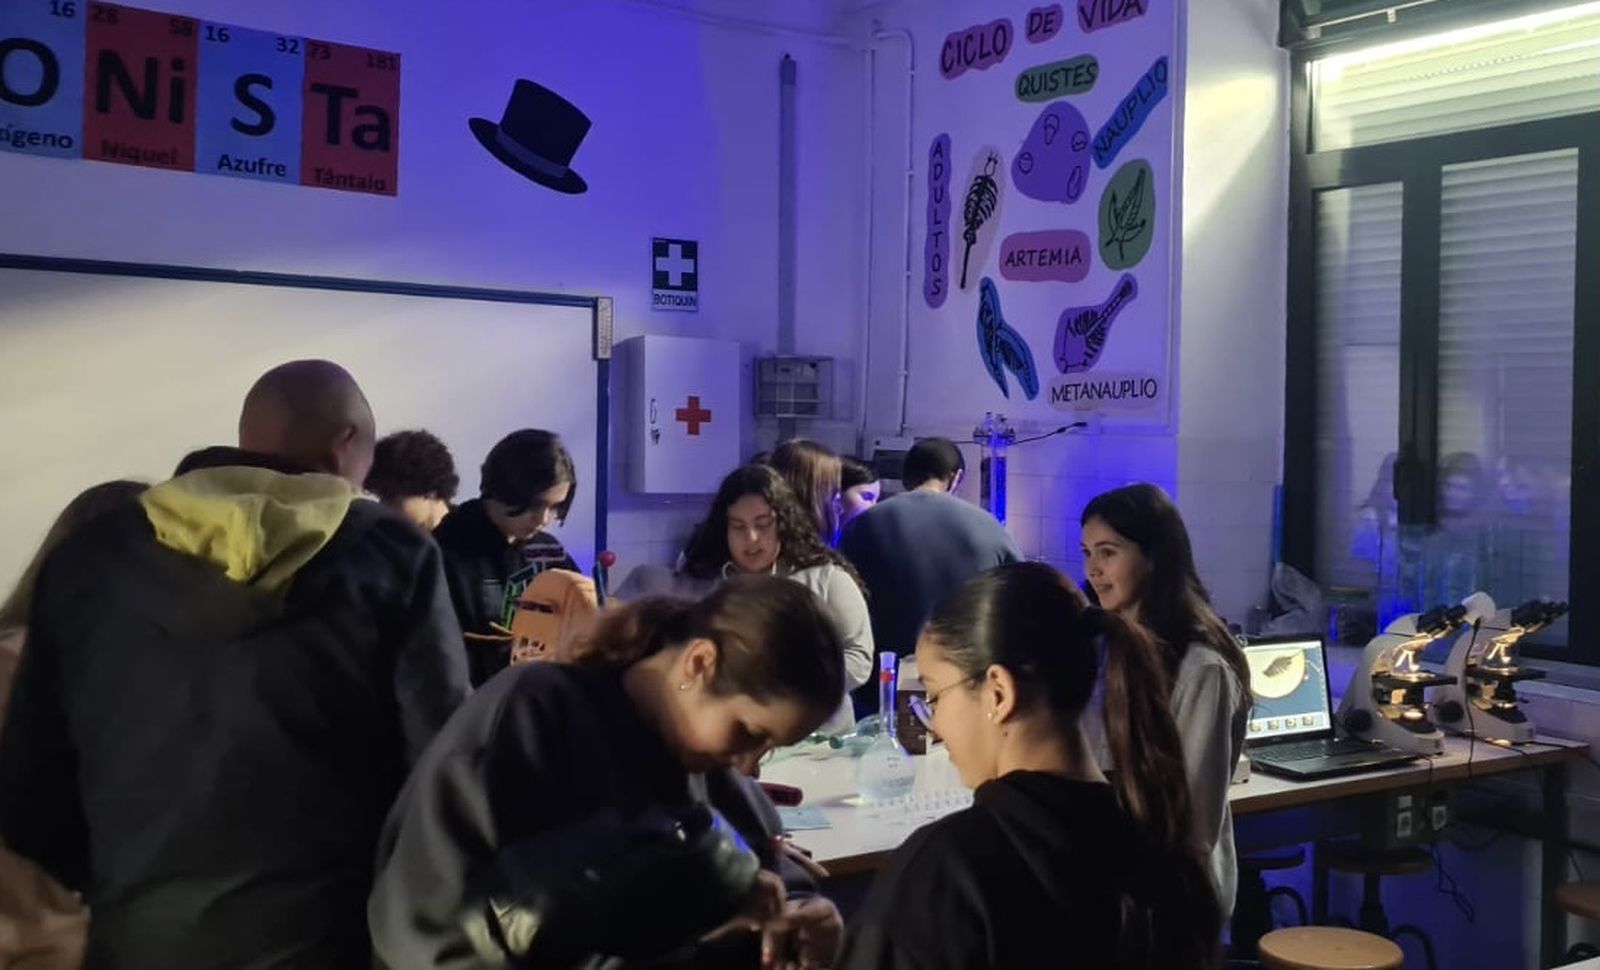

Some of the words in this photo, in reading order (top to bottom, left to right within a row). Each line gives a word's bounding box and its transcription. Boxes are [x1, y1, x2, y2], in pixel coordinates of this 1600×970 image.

[50, 0, 75, 18] 16
[205, 25, 230, 43] 16
[276, 37, 299, 54] 32
[940, 24, 1008, 73] CICLO
[1028, 11, 1056, 37] DE
[1080, 0, 1142, 28] VIDA
[310, 42, 332, 61] 73
[366, 53, 397, 71] 181
[0, 37, 60, 107] O
[95, 49, 185, 124] Ni
[1018, 62, 1098, 96] QUISTES
[230, 73, 275, 136] S
[310, 83, 391, 152] Ta
[1094, 58, 1168, 161] NAUPLIO
[217, 153, 286, 178] Azufre
[931, 141, 945, 296] ADULTOS
[1005, 247, 1083, 267] ARTEMIA
[1052, 378, 1158, 405] METANAUPLIO
